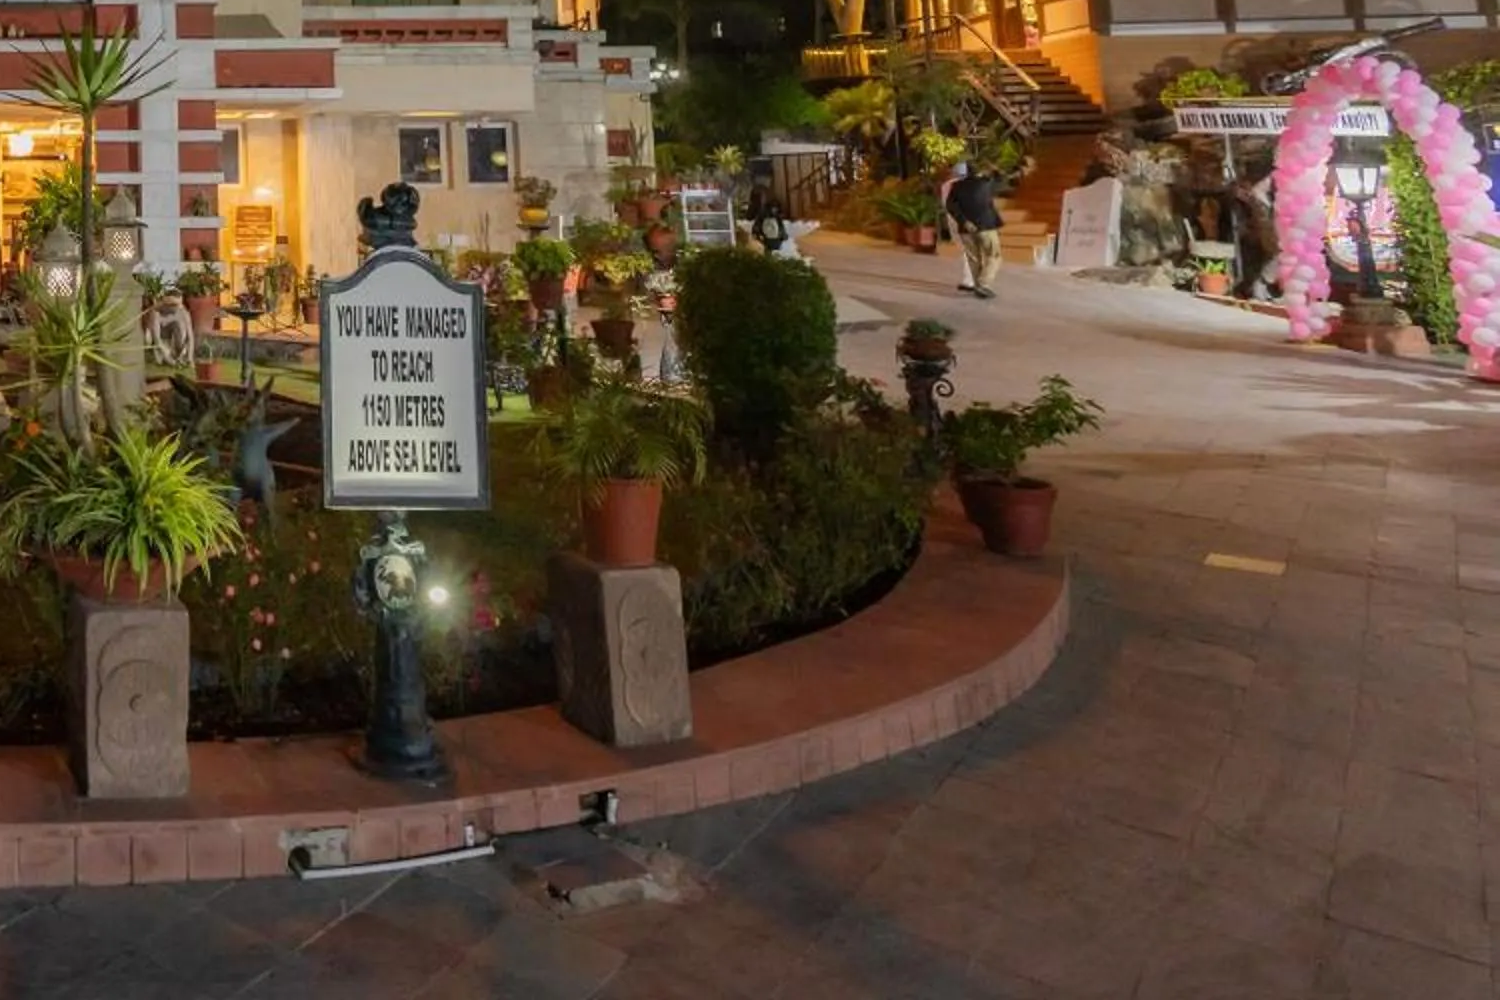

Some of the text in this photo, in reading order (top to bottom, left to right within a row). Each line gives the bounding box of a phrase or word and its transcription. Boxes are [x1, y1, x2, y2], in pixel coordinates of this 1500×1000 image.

[336, 305, 467, 339] YOU HAVE MANAGED
[371, 350, 434, 383] TO REACH
[362, 394, 445, 428] 1150 METRES
[348, 439, 462, 473] ABOVE SEA LEVEL
